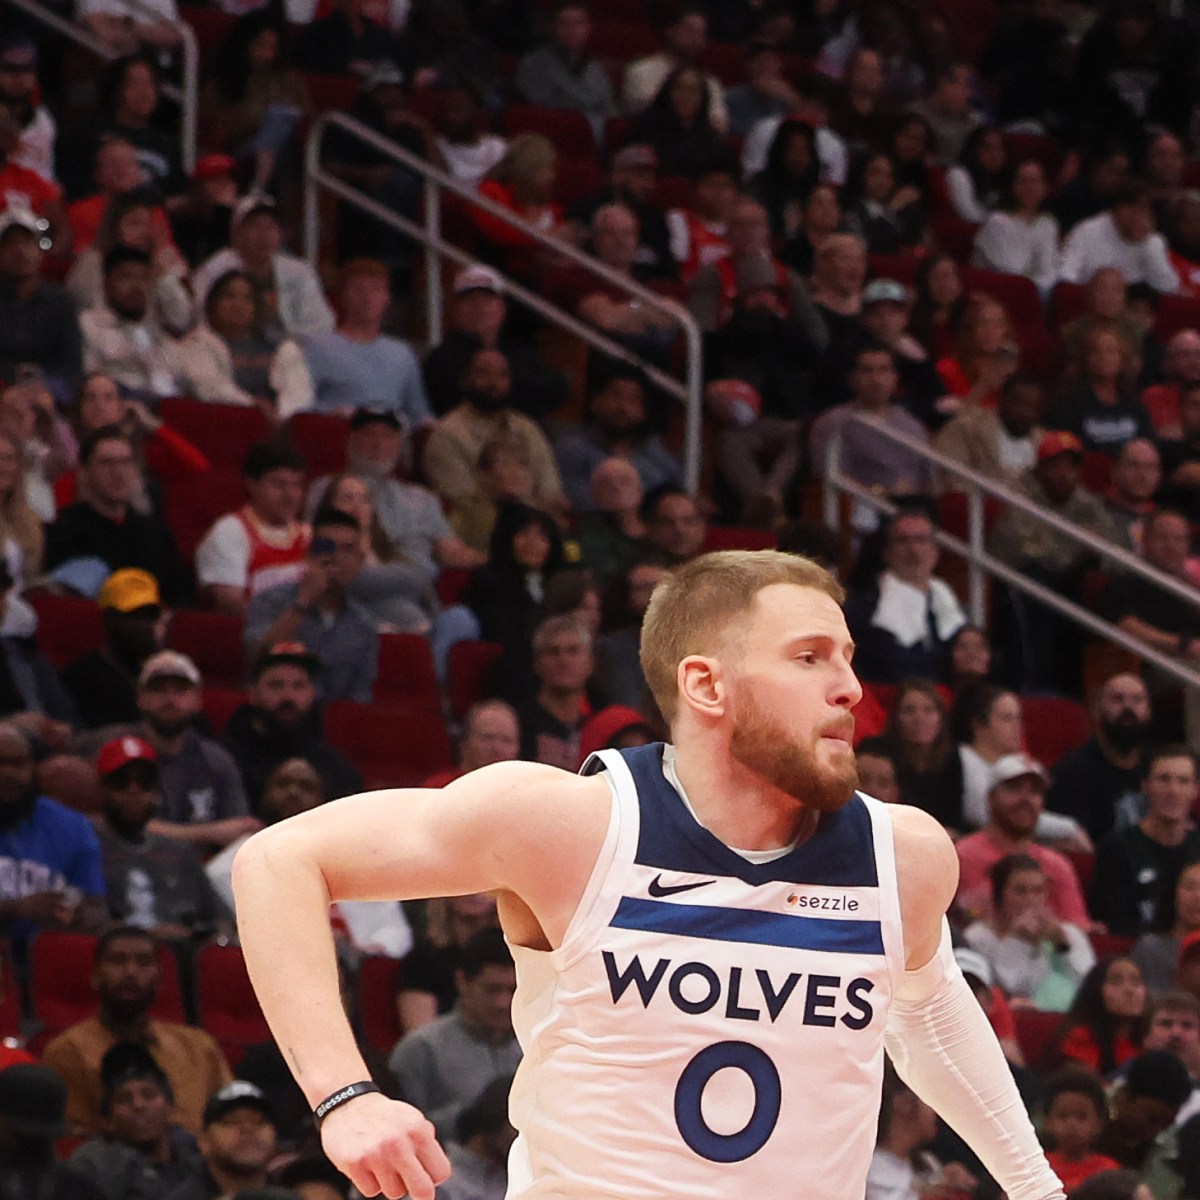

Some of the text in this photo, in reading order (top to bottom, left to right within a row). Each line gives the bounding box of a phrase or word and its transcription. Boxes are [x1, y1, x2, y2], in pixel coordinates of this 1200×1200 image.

[799, 895, 859, 911] sezzle
[601, 950, 875, 1030] WOLVES
[316, 1086, 356, 1118] Blessed
[673, 1040, 782, 1163] 0
